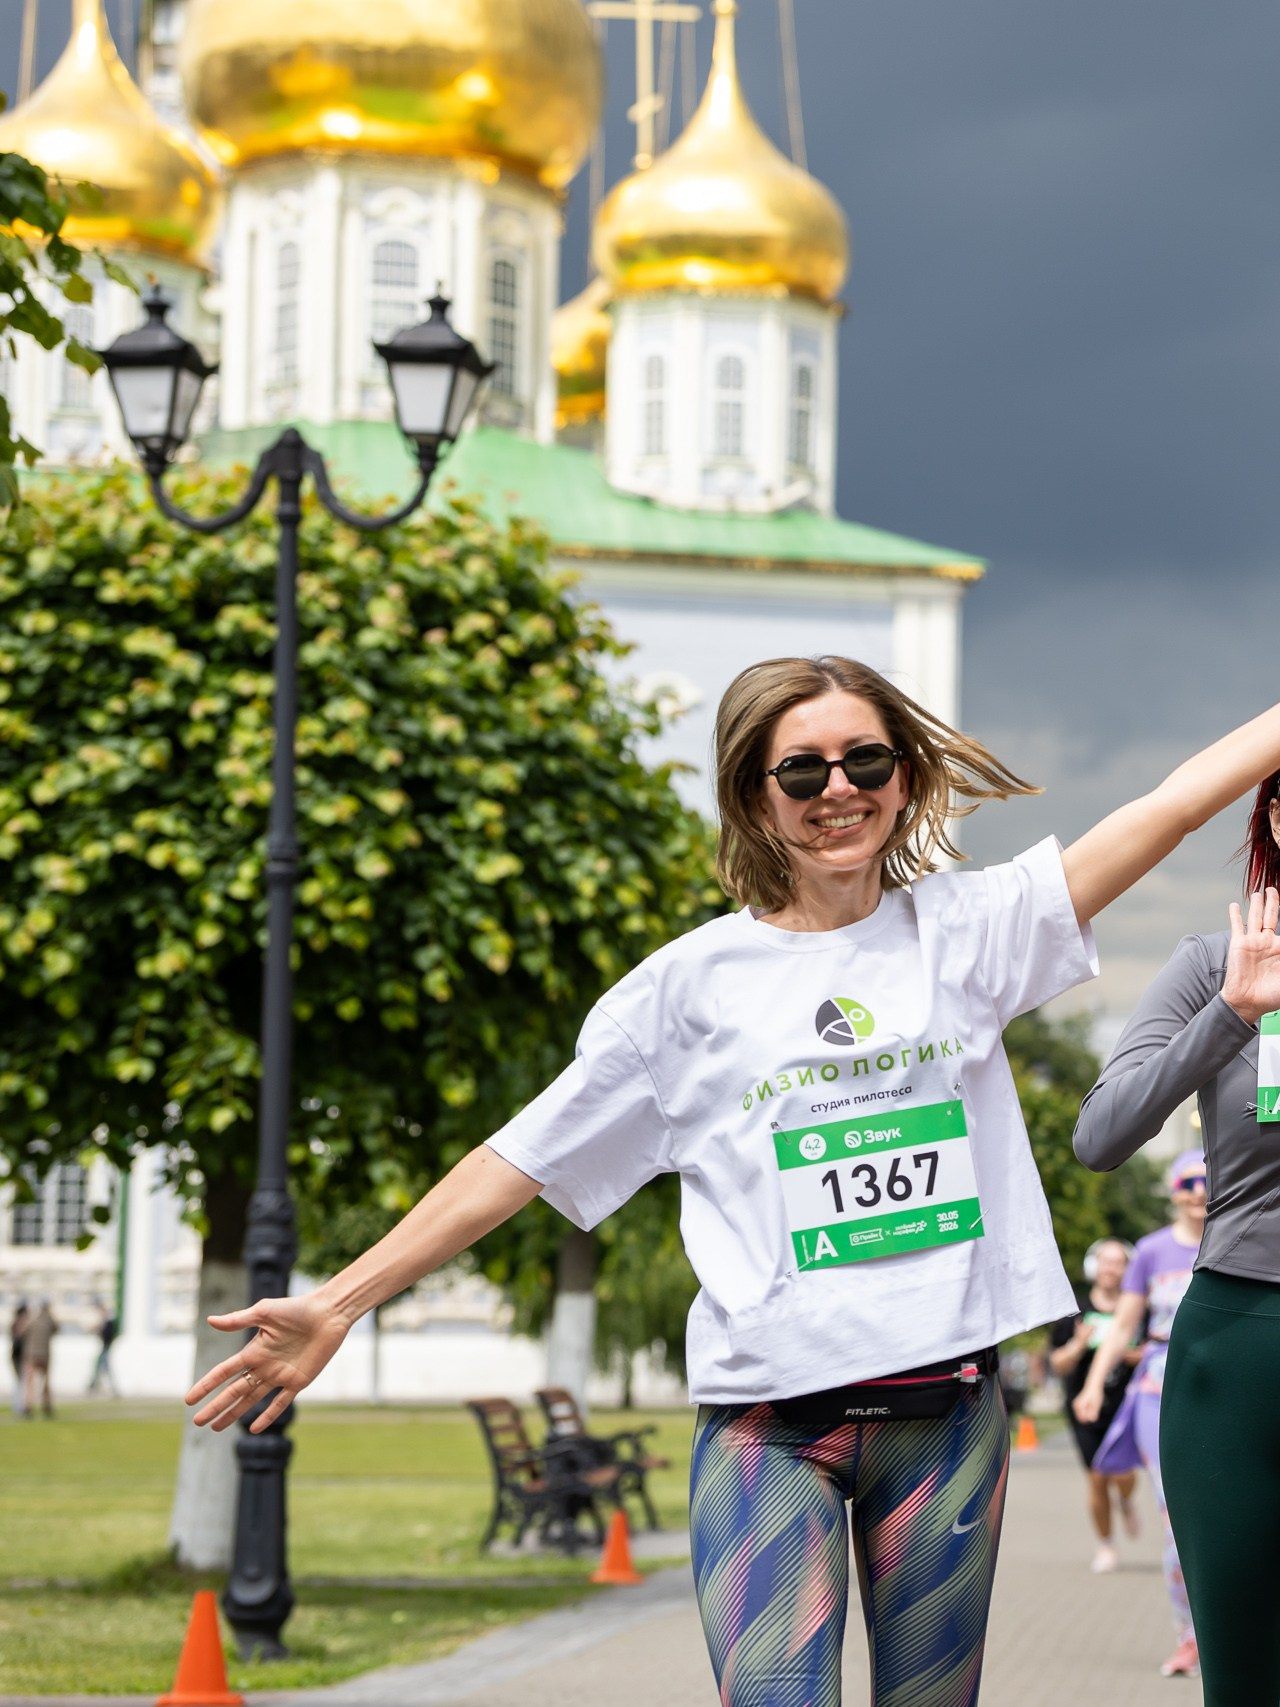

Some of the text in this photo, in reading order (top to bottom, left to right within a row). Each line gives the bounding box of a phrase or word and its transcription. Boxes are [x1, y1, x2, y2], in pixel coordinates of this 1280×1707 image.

[811, 1086, 912, 1113] студия пилатеса
[863, 1127, 902, 1144] Звук
[805, 1138, 821, 1151] 4,2
[821, 1150, 940, 1214] 1367
[936, 1210, 959, 1223] 30.05
[938, 1221, 959, 1233] 2026
[845, 1407, 888, 1416] FITLETIC
